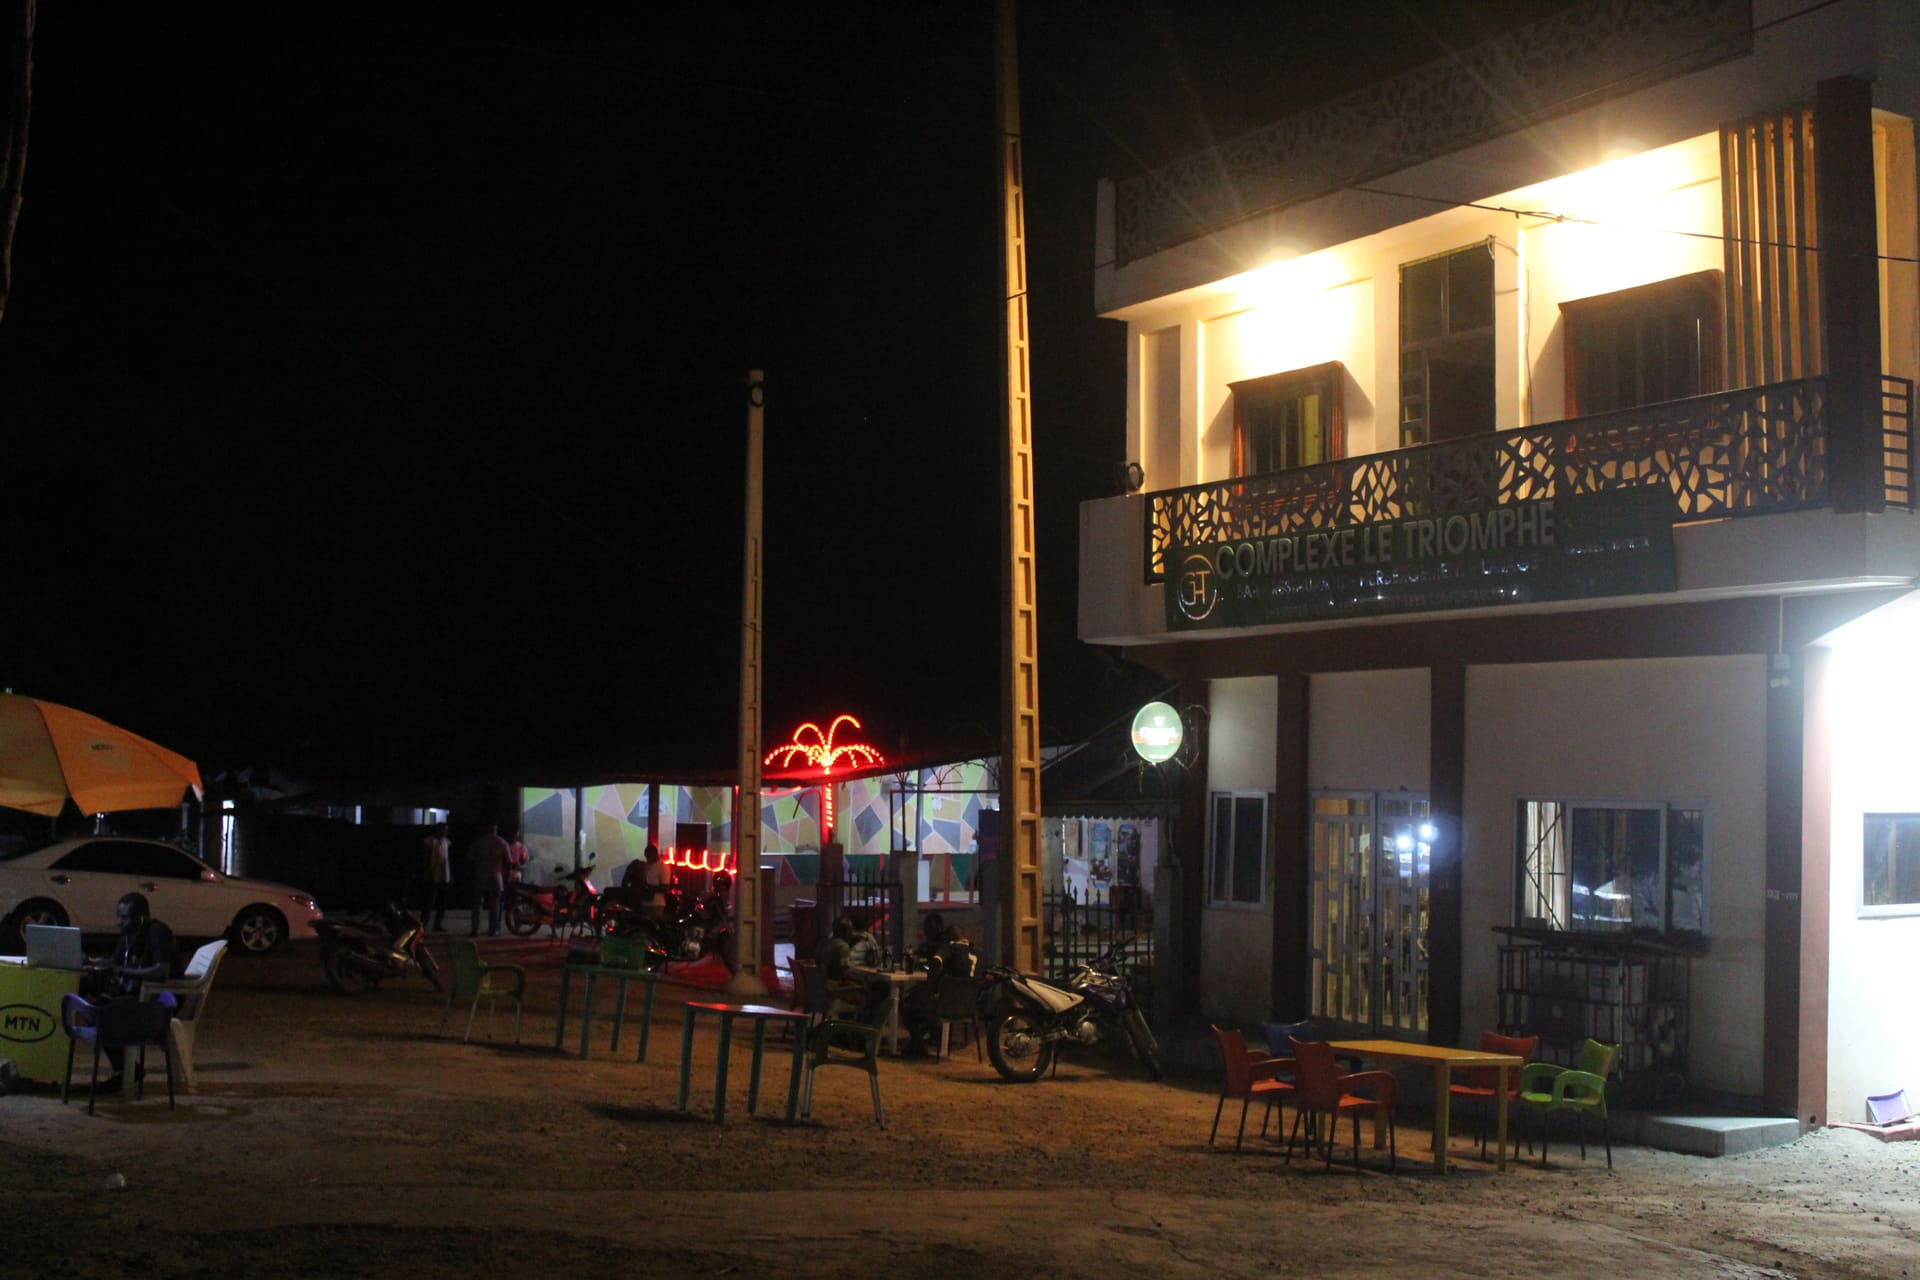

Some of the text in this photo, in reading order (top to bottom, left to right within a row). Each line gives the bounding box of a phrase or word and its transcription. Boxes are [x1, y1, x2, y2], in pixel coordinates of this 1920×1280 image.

[1215, 528, 1355, 580] COMPLEXE
[1363, 524, 1393, 562] LE
[1403, 500, 1555, 559] TRIOMPHE
[4, 1015, 41, 1033] MTN
